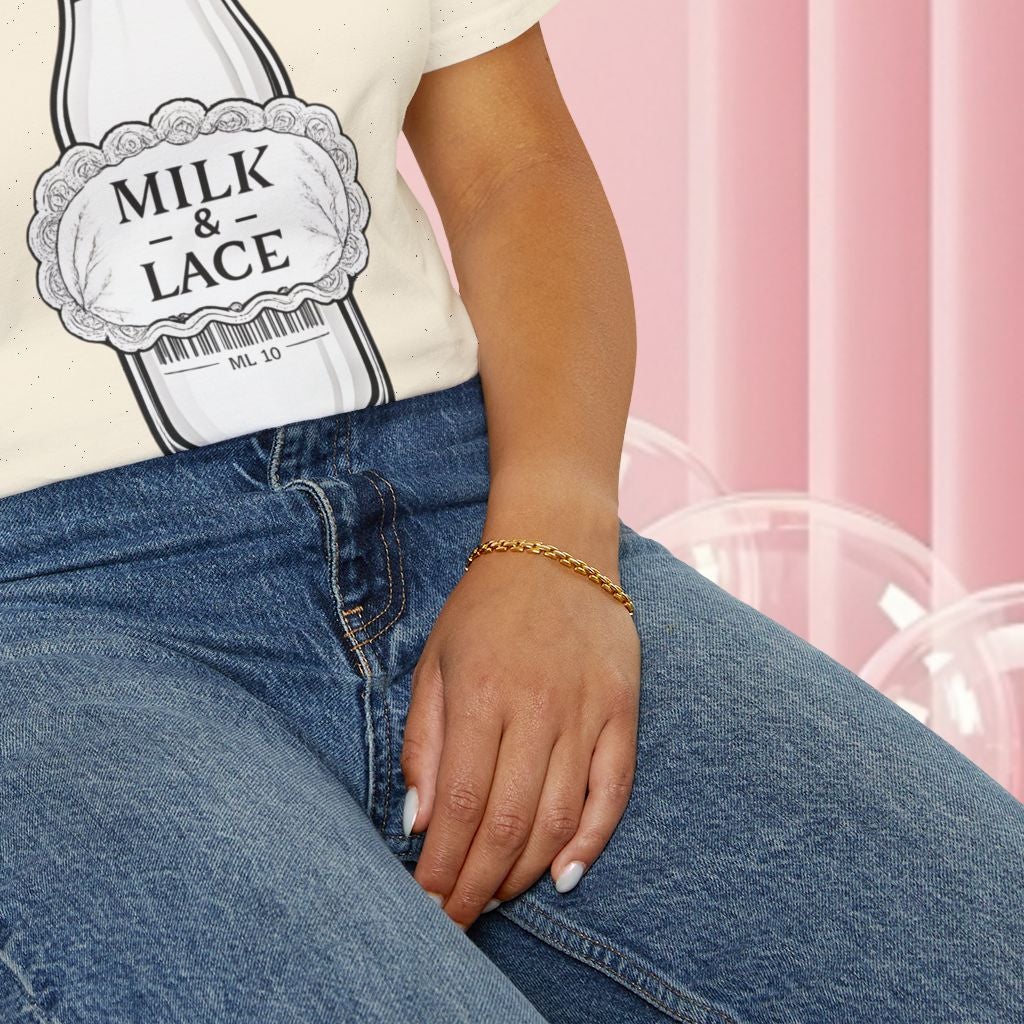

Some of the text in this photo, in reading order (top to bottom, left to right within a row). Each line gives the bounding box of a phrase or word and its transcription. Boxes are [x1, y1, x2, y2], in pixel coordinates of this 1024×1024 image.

[109, 144, 274, 225] MILK
[194, 207, 221, 238] &
[140, 229, 291, 302] LACE
[228, 347, 281, 370] ML 10
